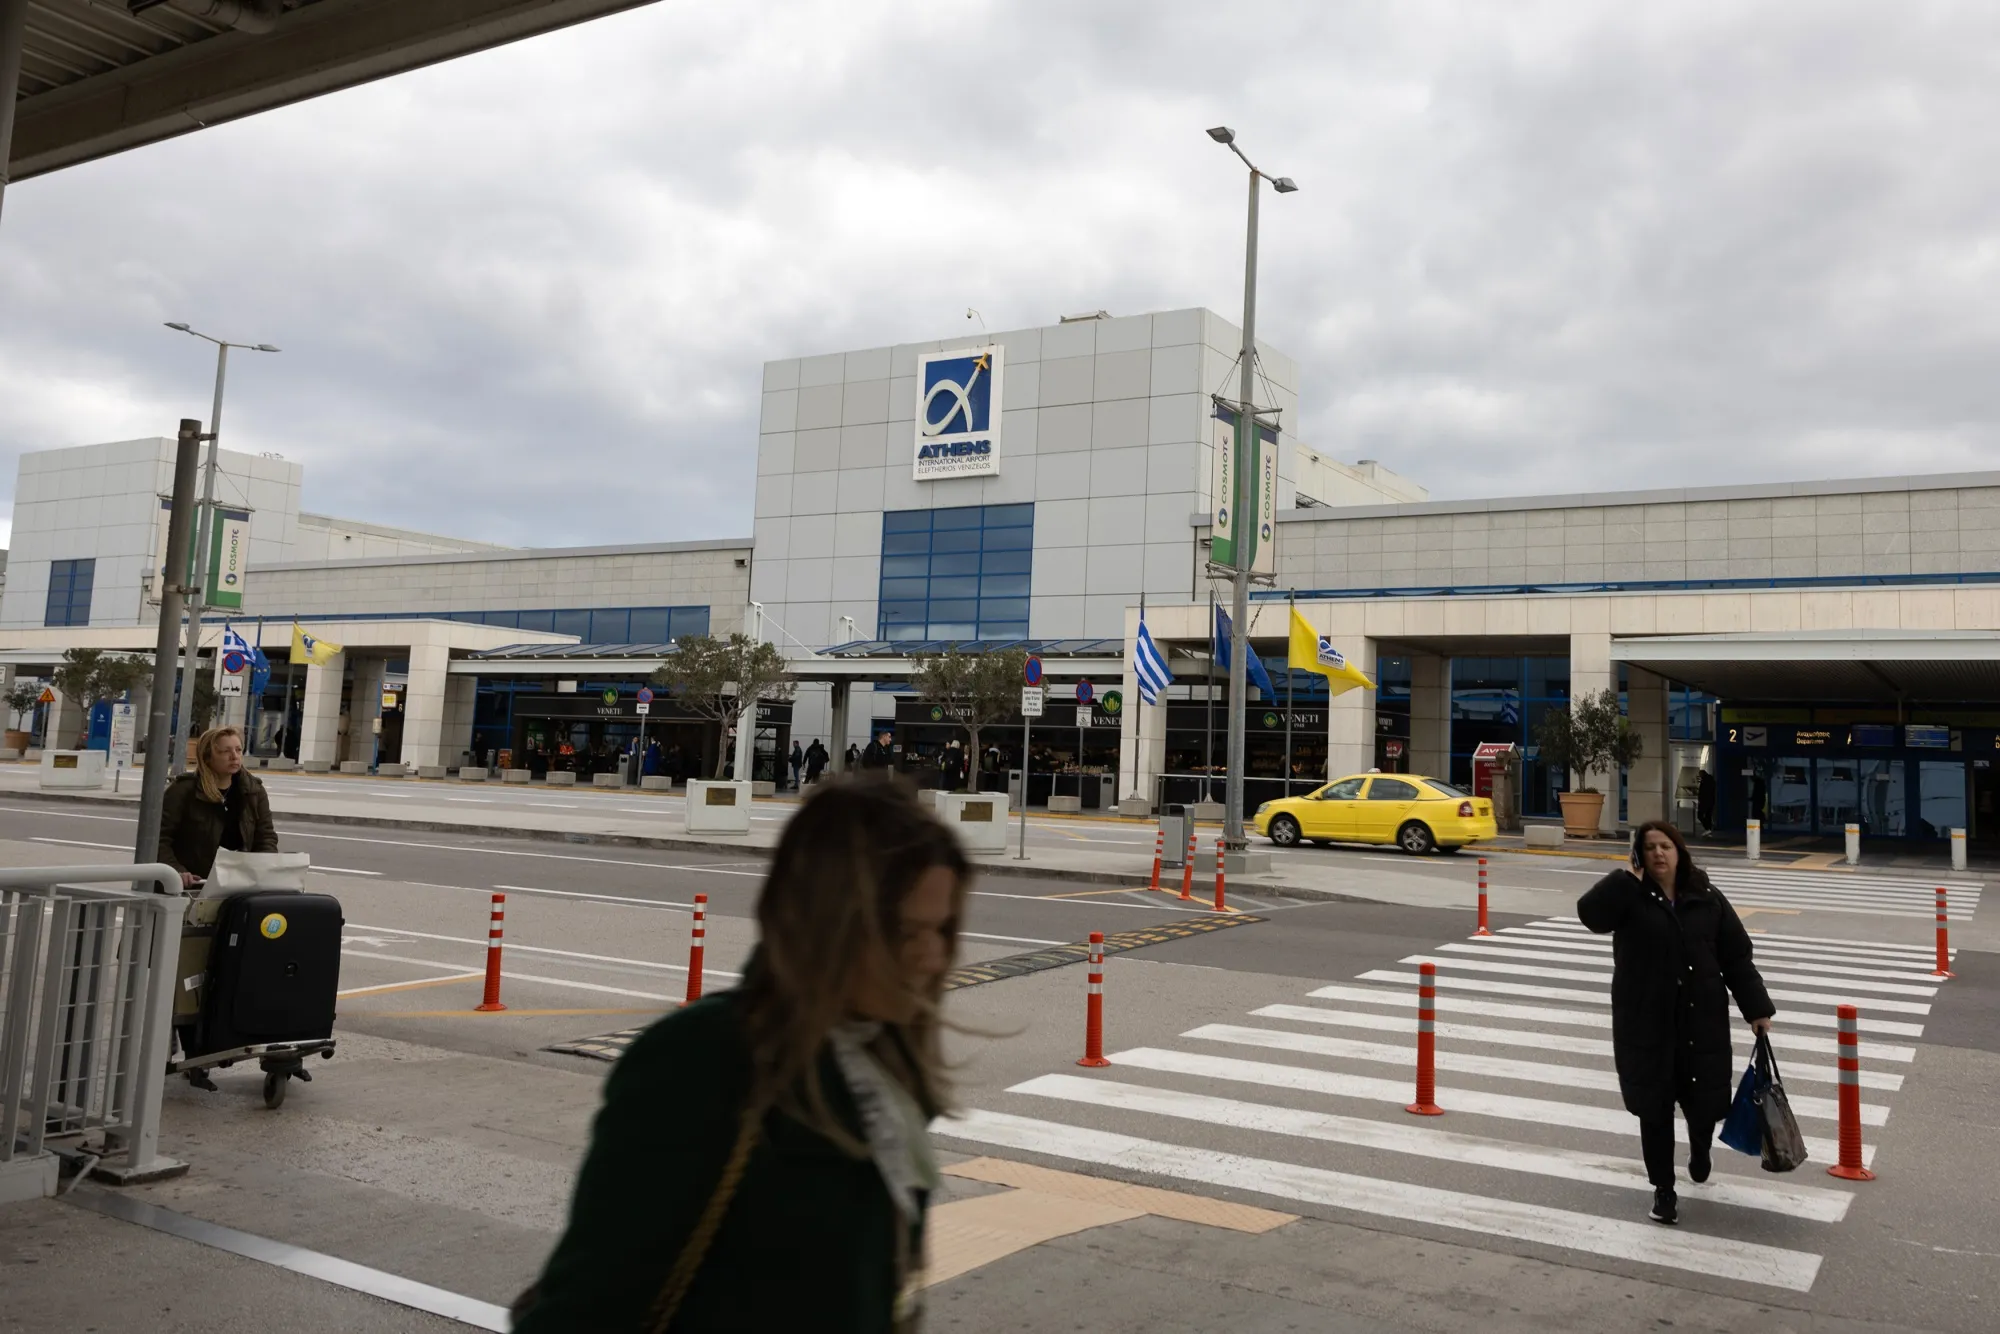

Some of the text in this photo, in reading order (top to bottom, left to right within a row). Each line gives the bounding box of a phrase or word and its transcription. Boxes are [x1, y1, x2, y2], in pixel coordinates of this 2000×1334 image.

[918, 440, 991, 459] ATHENS
[918, 455, 990, 466] INTERNATIONAL AIRPORT
[918, 463, 990, 474] ELEFTHERIOS VENIZELOS
[1319, 653, 1344, 664] ATHENS
[756, 707, 771, 715] NETI
[1729, 729, 1737, 743] 2
